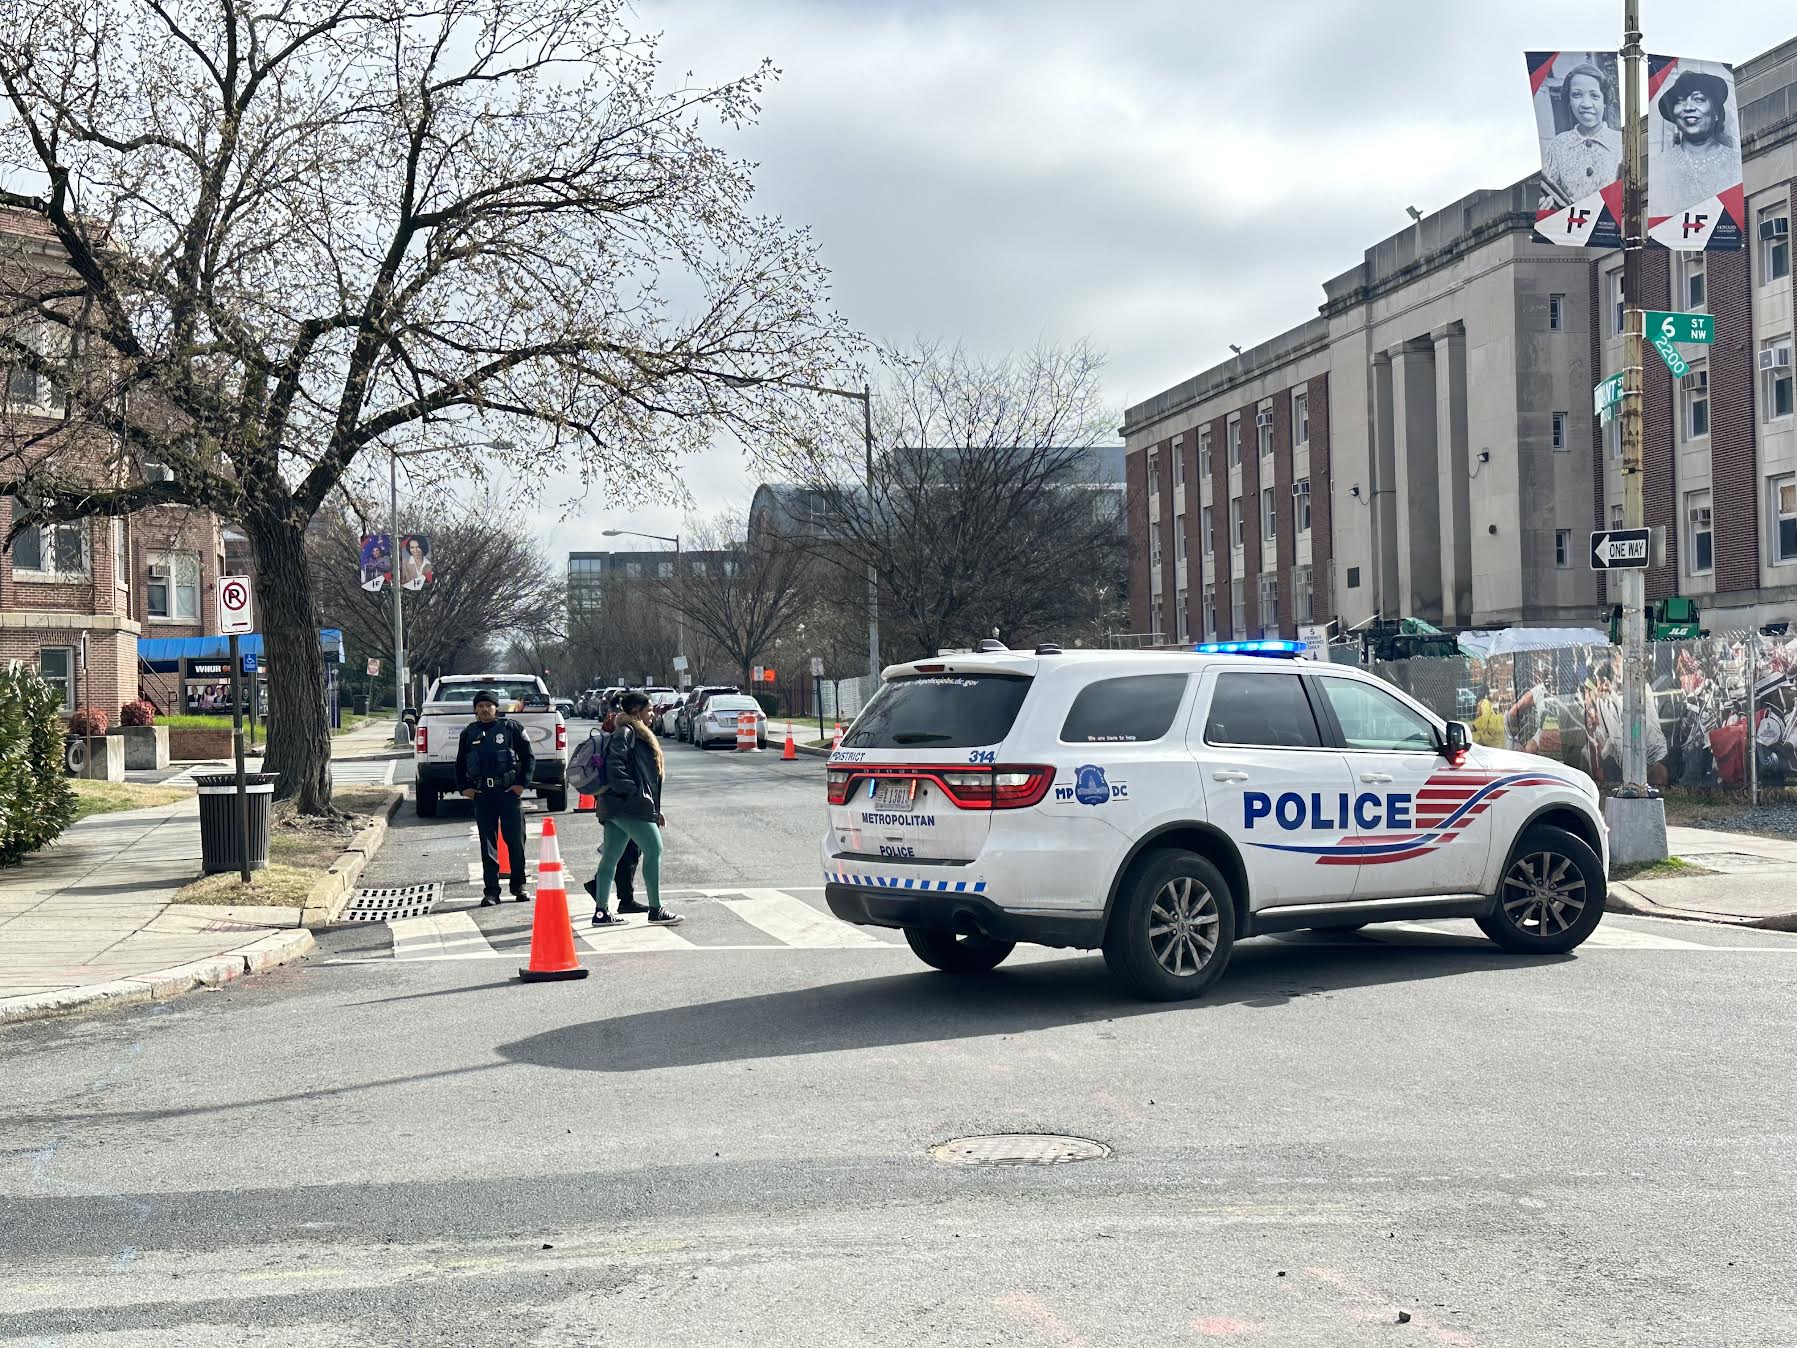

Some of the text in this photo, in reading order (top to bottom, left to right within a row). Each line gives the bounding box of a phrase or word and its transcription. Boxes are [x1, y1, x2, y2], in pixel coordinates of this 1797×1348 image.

[1661, 316, 1676, 338] 6
[1691, 318, 1705, 329] ST
[1690, 329, 1707, 340] NW
[1655, 335, 1685, 374] 2200
[1609, 541, 1644, 558] ONE WAY
[1668, 627, 1689, 635] JLG
[194, 665, 222, 673] WHUR
[968, 750, 995, 763] 314
[1055, 787, 1074, 800] MP
[1111, 784, 1128, 797] DC
[1243, 791, 1412, 831] POLICE
[861, 812, 936, 827] METROPOLITAN
[879, 845, 915, 857] POLICE
